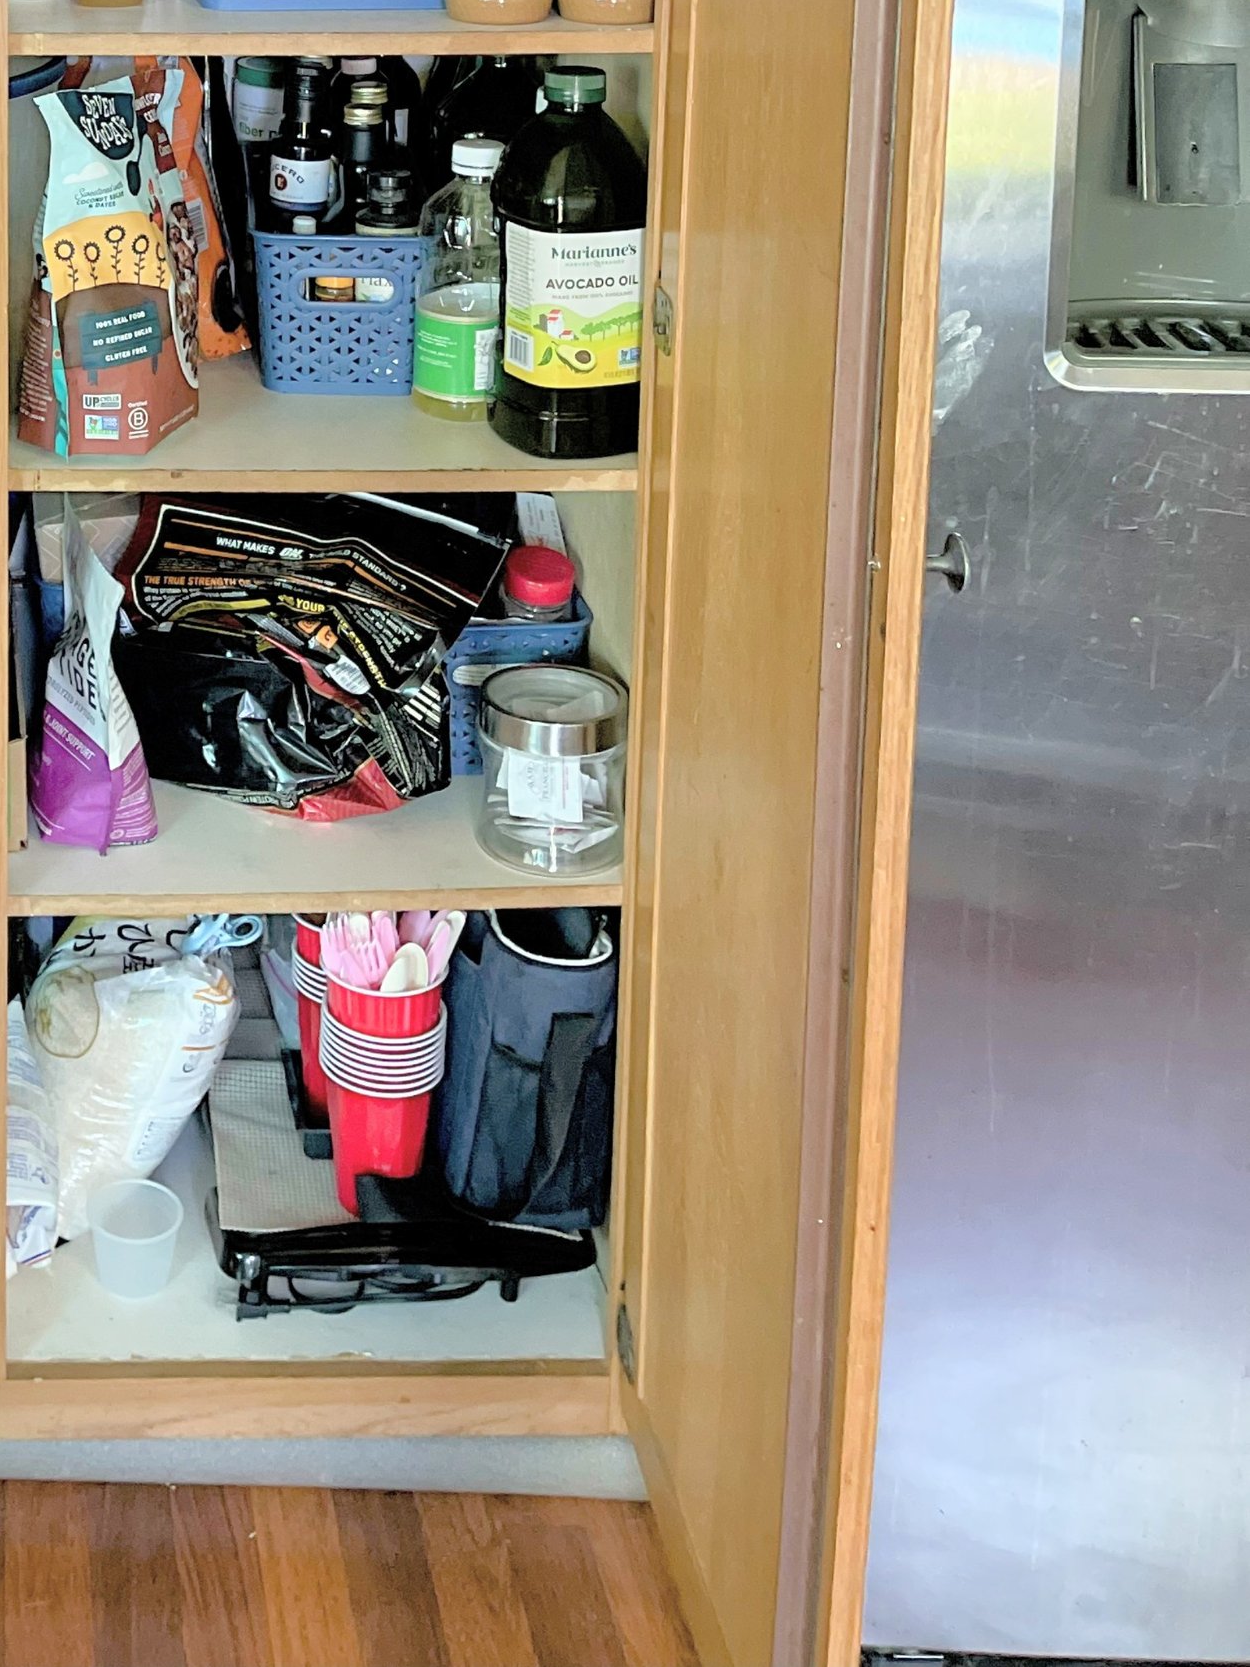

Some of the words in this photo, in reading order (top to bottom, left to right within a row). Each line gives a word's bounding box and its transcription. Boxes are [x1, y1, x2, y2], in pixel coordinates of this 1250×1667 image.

[82, 94, 116, 119] SEVEN
[79, 112, 133, 150] SUNDAYS
[239, 122, 263, 138] fiber
[75, 187, 112, 201] Sweetened
[76, 195, 108, 205] COCONUT
[551, 243, 637, 260] Marianne's
[546, 277, 615, 289] AVOCADO
[619, 276, 638, 286] OIL
[95, 321, 112, 329] 100%
[113, 317, 129, 326] REAL
[129, 310, 146, 321] FOOD
[105, 333, 133, 344] REFINED
[134, 327, 153, 338] SUGAR
[105, 350, 131, 362] GLUTEN
[131, 346, 148, 356] FREE
[84, 397, 100, 407] UP
[133, 412, 144, 426] B
[216, 536, 241, 549] WHAT
[243, 540, 276, 555] MAKES
[145, 576, 161, 584] THE
[163, 576, 185, 585] TRUE
[188, 577, 236, 586] STRENGTH
[295, 597, 326, 613] YOUR
[50, 719, 66, 738] JOINT
[65, 733, 96, 760] SUPPORT
